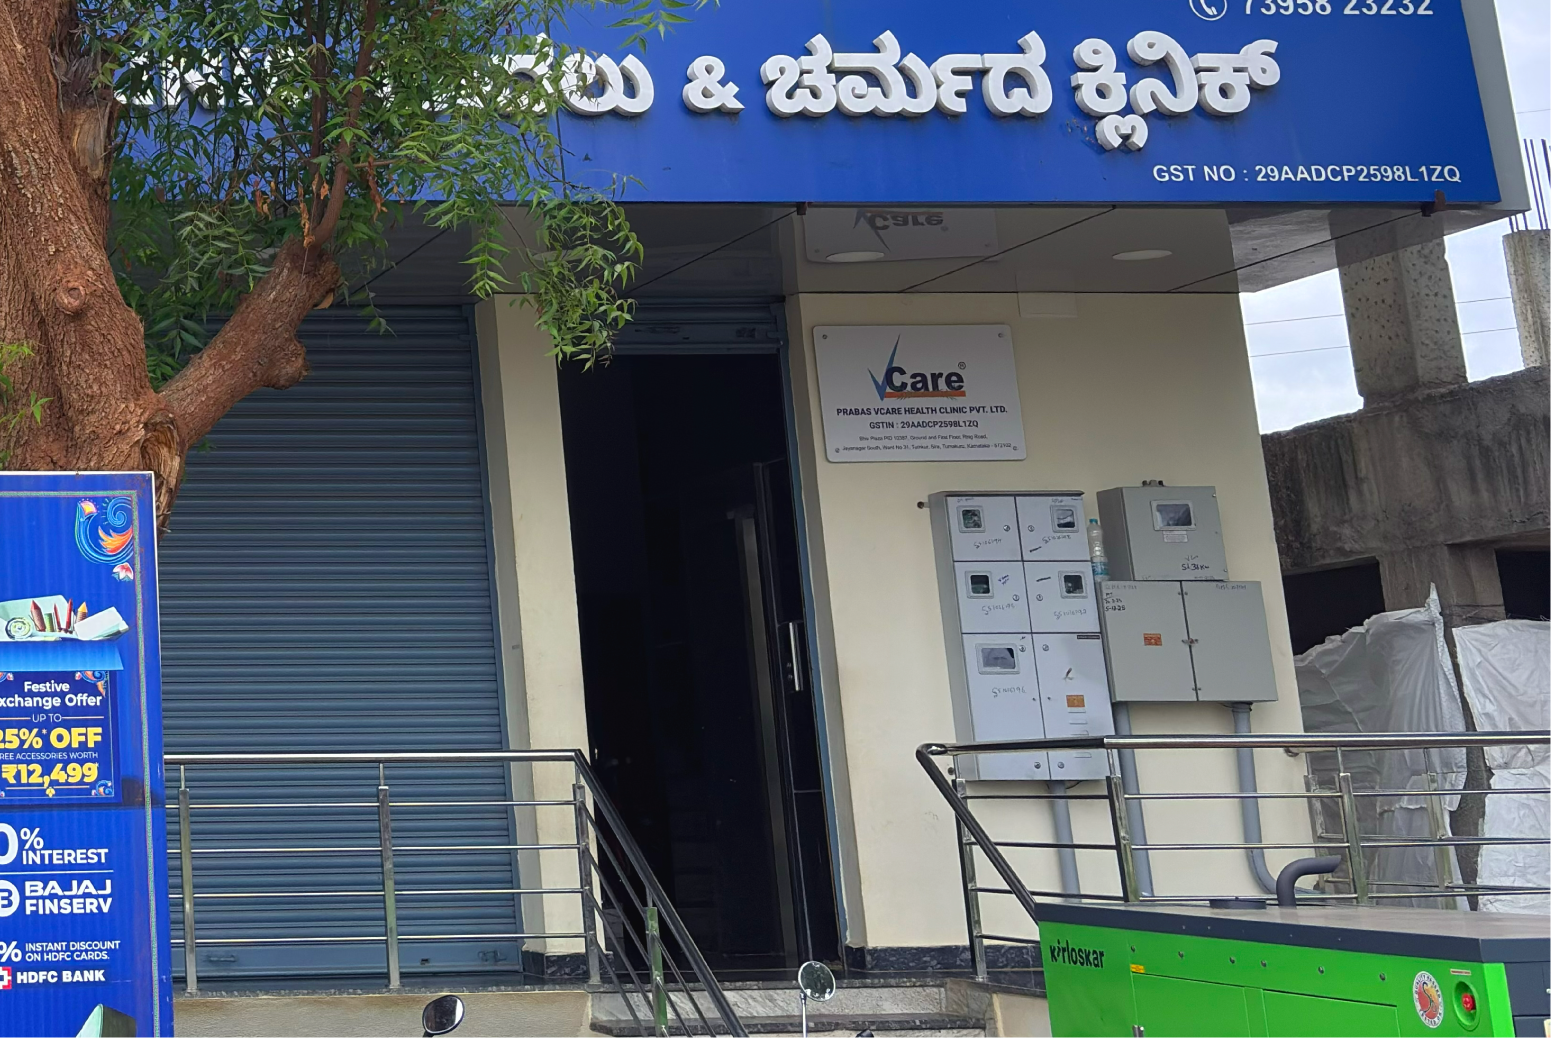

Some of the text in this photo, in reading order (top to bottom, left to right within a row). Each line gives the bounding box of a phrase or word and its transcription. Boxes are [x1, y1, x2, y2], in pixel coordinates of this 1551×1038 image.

[683, 55, 746, 114] &
[762, 30, 1054, 118] ಚರ್ಮದ
[1070, 30, 1282, 152] ಕ್ಲಿನಿಕ್
[1152, 165, 1462, 184] GST NO 29AADCP2598L1ZQ
[836, 405, 1008, 416] PRABAS VCARE HEALTH CLINIC PVT. LTD.
[869, 419, 979, 429] GSTIN 29AADCP2598L1ZQ
[24, 680, 70, 693] Festive
[65, 693, 103, 707] Offer
[32, 713, 62, 723] UP TO
[50, 727, 103, 749] OFF
[16, 751, 68, 761] ACCESSORIES
[69, 751, 99, 760] WORTH
[22, 848, 109, 865] INTEREST
[24, 879, 112, 897] BAJAJ
[24, 897, 112, 915] FINSERV
[25, 940, 121, 952] INSTANT DISCOUNT
[25, 950, 110, 962] ON HDFC CARDS.
[16, 969, 106, 984] HDFC BANK
